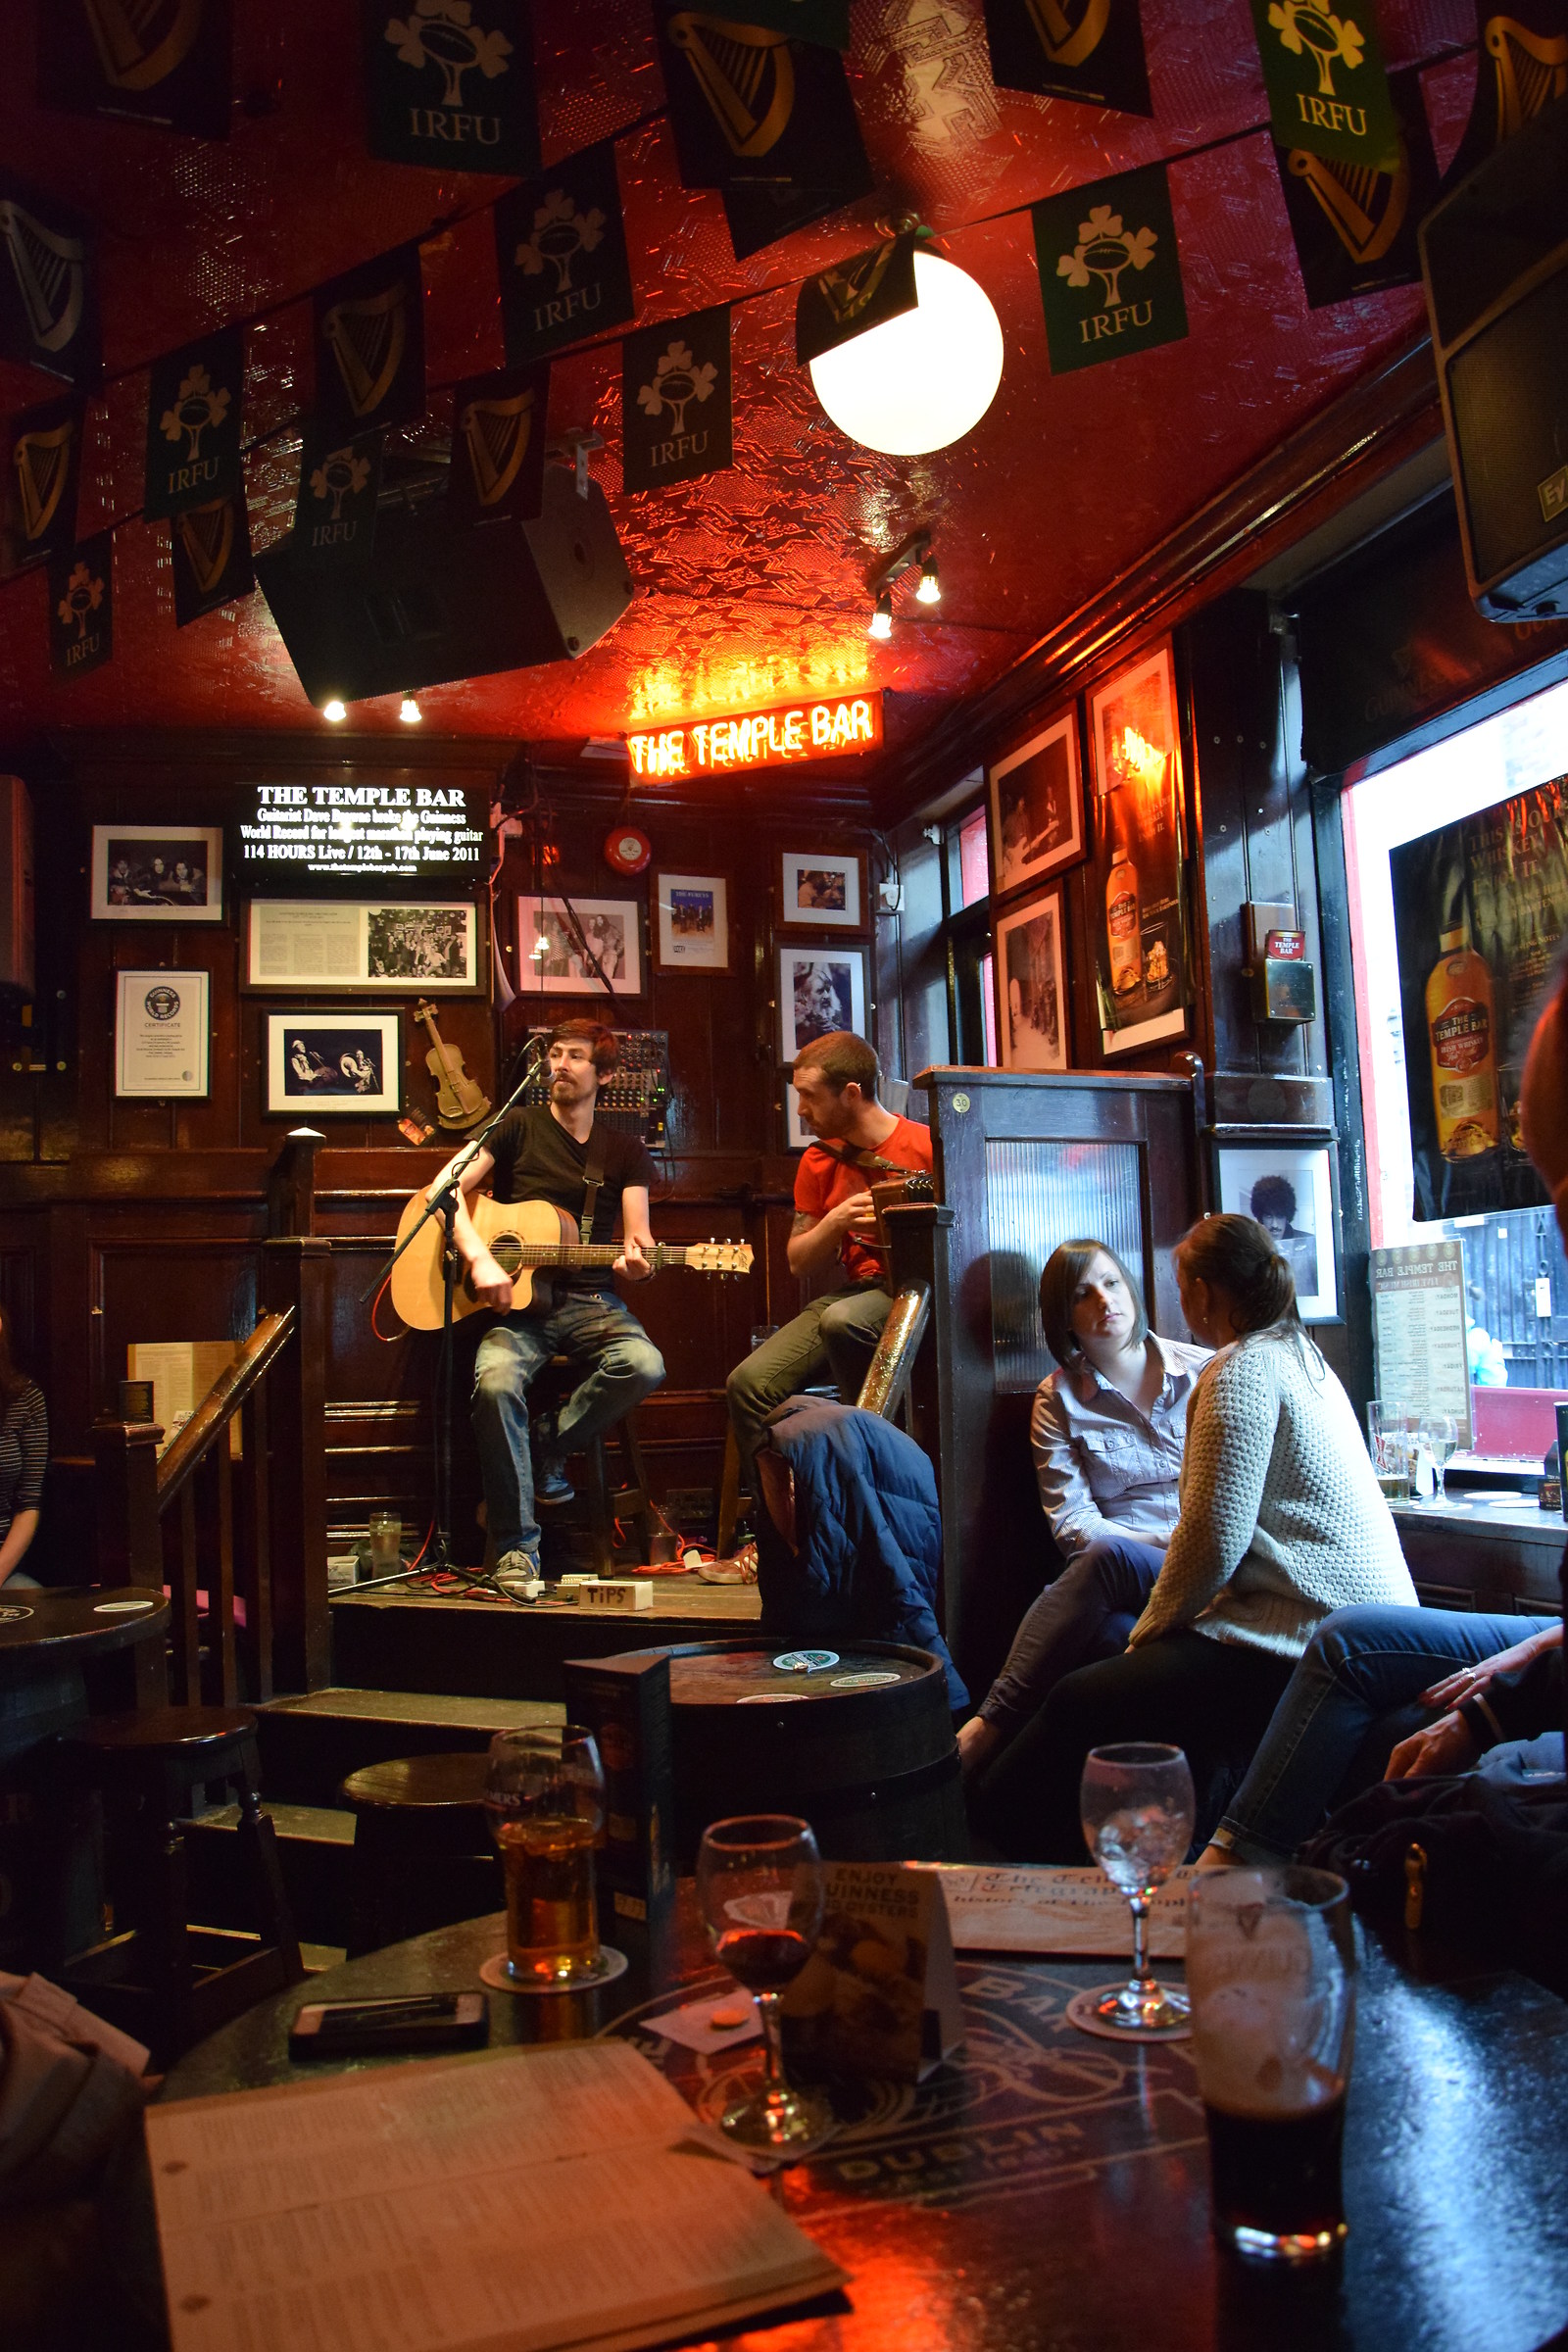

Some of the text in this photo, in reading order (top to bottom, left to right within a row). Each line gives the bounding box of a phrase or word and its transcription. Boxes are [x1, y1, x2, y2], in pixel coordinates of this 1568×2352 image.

[410, 107, 502, 145] IRFU
[1296, 93, 1366, 136] IRFU
[532, 281, 602, 333] IRFU
[1078, 298, 1152, 344] IRFU
[650, 429, 710, 468] IRFU
[167, 455, 220, 495] IRFU
[311, 519, 359, 547] IRFU
[66, 632, 100, 667] IRFU
[630, 699, 874, 774] THE TEMPLE BAR
[257, 786, 466, 808] THE TEMPLE BAR
[257, 808, 303, 823] Guitarist
[303, 808, 331, 823] Dave
[372, 809, 401, 824] broke
[420, 810, 466, 825] Guinness
[240, 824, 271, 840] World
[272, 825, 310, 840] Record
[311, 825, 327, 840] for
[414, 827, 453, 845] playing
[453, 828, 484, 845] guitar
[243, 844, 266, 859] 114
[268, 845, 316, 859] HOURS
[318, 845, 347, 859] Live
[357, 846, 383, 860] 12th
[394, 846, 420, 861] 17th
[421, 847, 451, 861] June
[452, 847, 480, 861] 2011
[1274, 941, 1300, 950] TEMPLE
[1435, 1018, 1488, 1042] TEMPLE BAR
[1451, 1014, 1469, 1026] THE
[956, 1099, 967, 1107] 30
[836, 1867, 898, 1886] ENJOY
[825, 1882, 919, 1905] UINNESS
